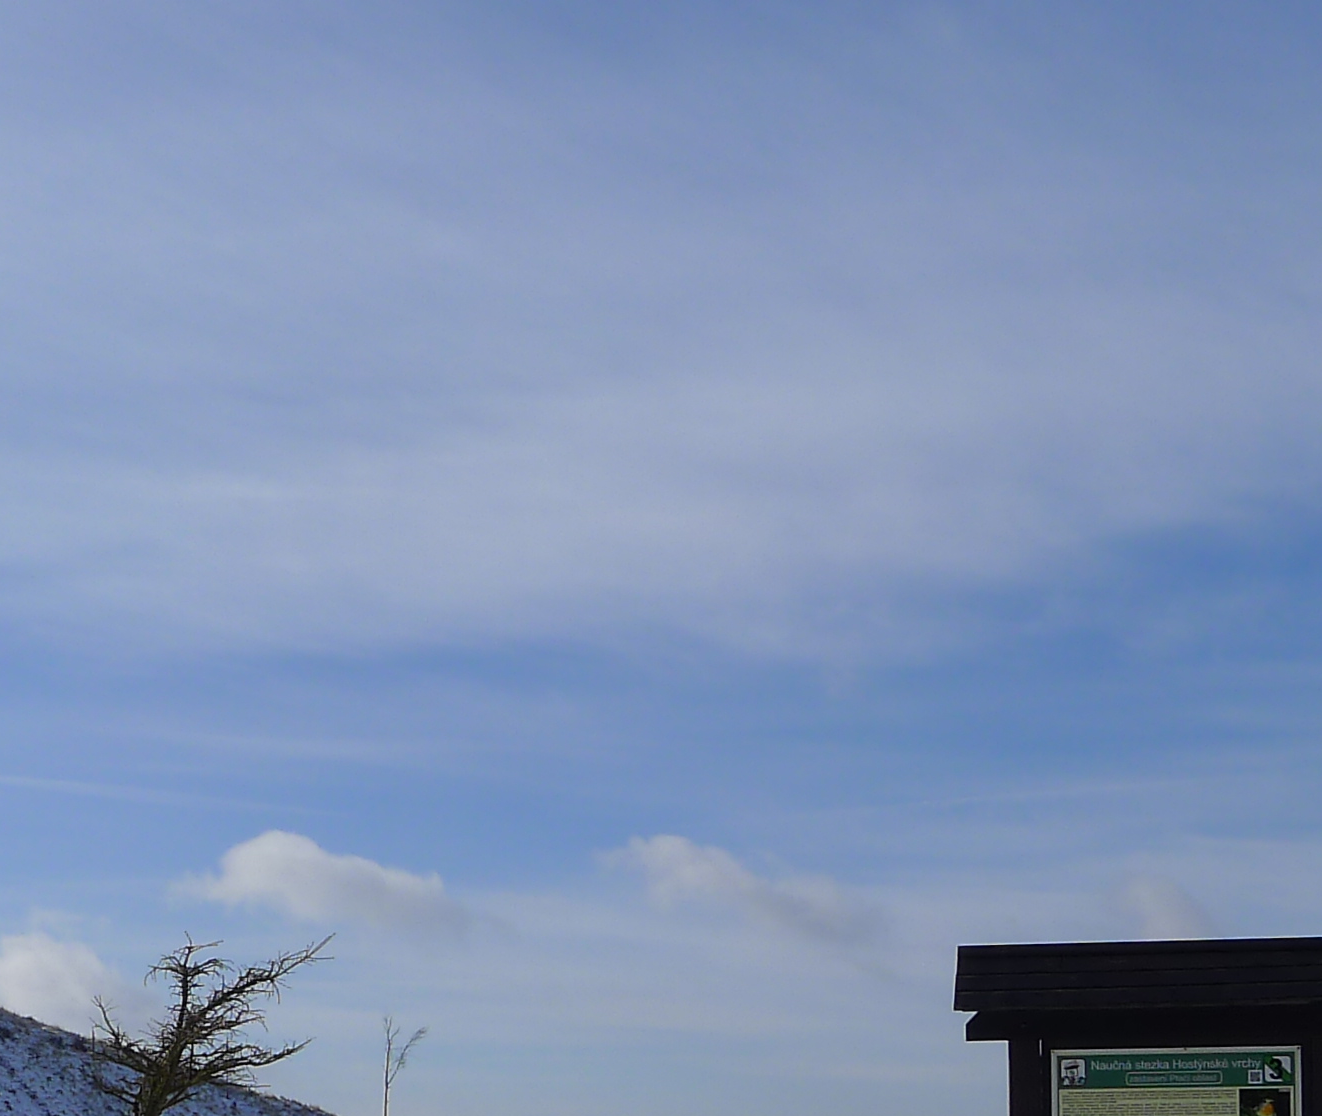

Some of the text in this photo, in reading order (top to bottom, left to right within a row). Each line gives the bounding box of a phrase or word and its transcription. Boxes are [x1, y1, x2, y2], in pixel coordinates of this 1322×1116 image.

[1090, 1057, 1262, 1073] Naučná stezka Hostýnské vrchy
[1269, 1058, 1284, 1081] 3
